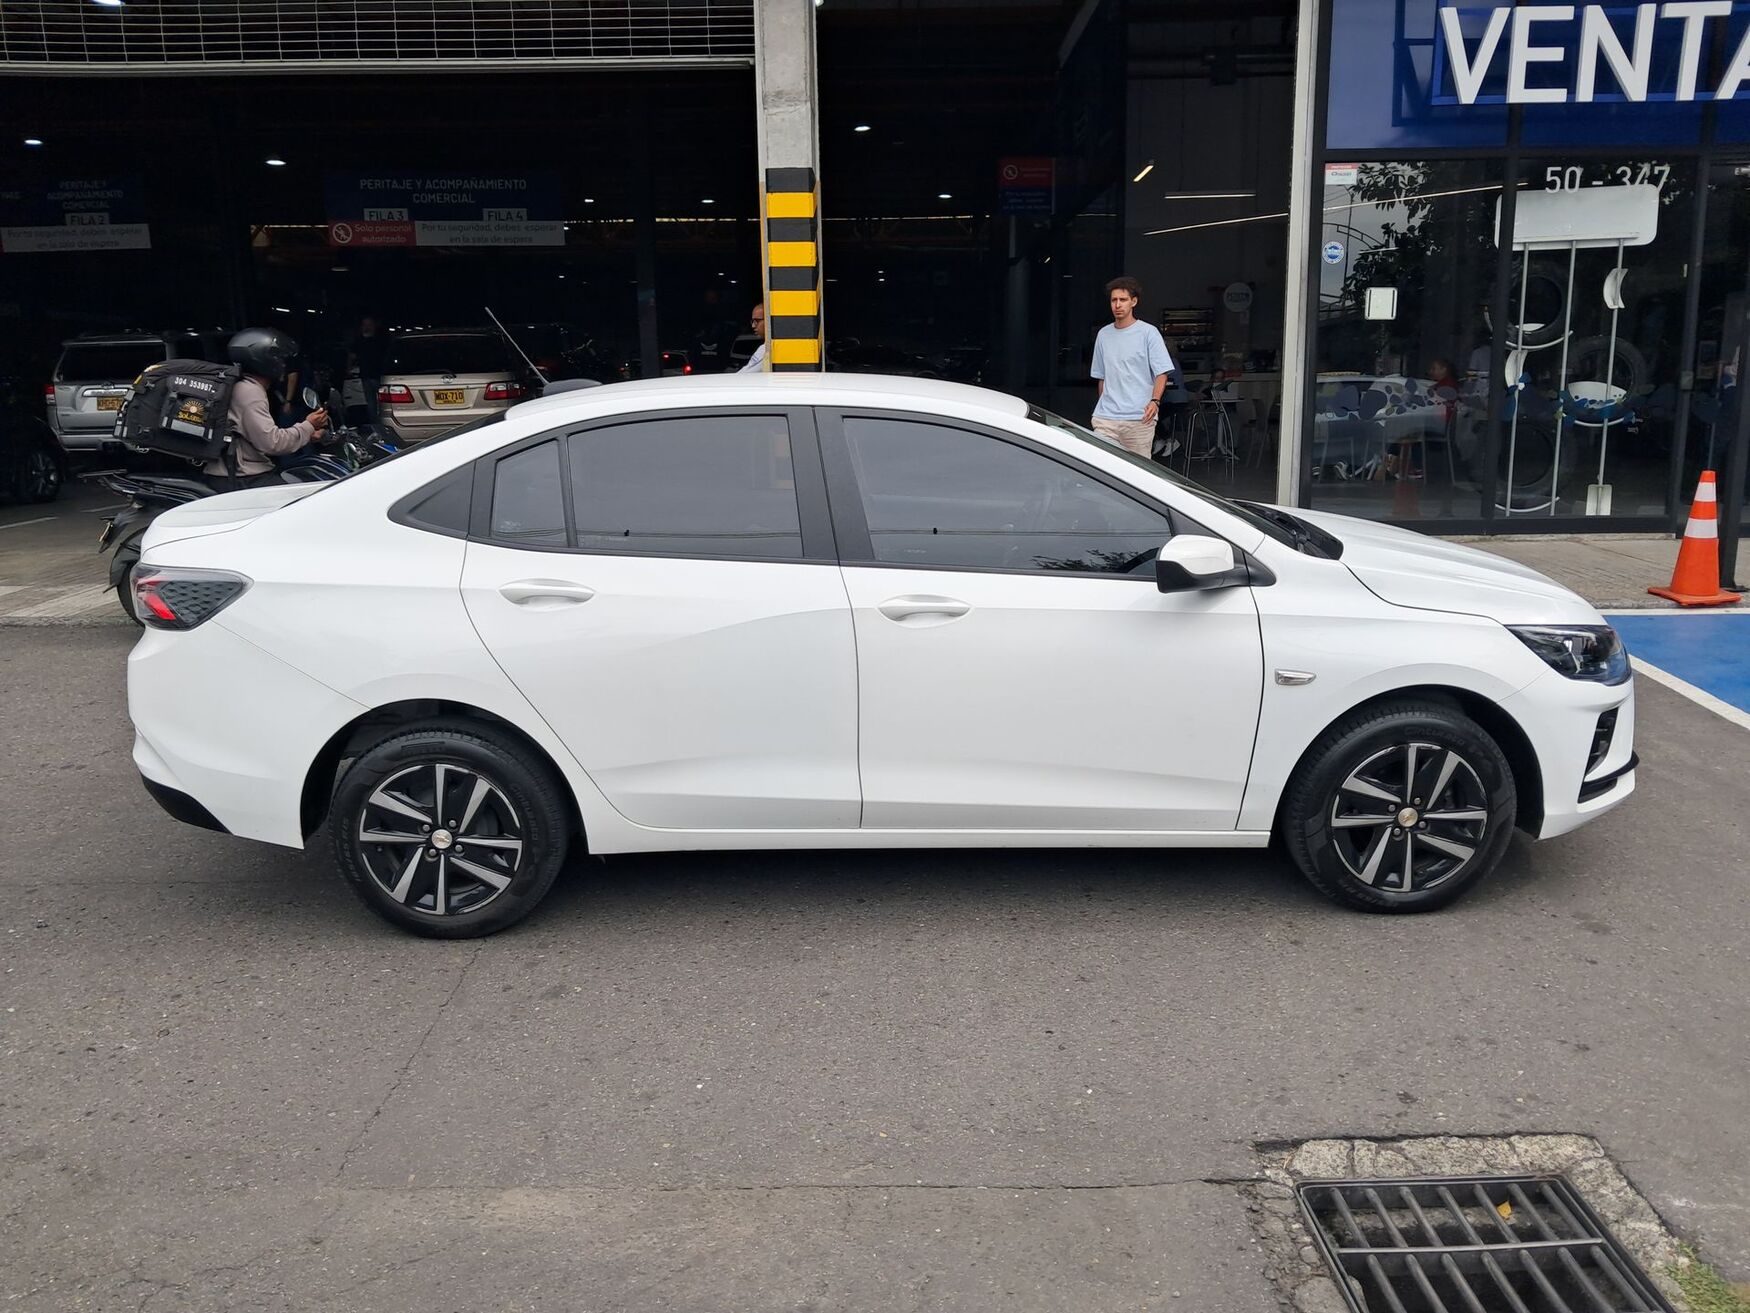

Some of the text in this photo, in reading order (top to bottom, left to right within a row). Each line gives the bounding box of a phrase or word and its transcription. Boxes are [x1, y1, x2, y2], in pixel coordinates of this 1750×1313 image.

[360, 177, 527, 190] PERITAJE Y ACOMPAÑAMIENTO
[1545, 165, 1581, 193] 50
[1616, 164, 1671, 192] 347
[413, 193, 476, 204] COMERCIAL
[70, 215, 97, 225] FILA
[369, 210, 405, 221] FILA 3
[487, 210, 524, 221] FILA 4
[355, 223, 411, 235] Solo personal
